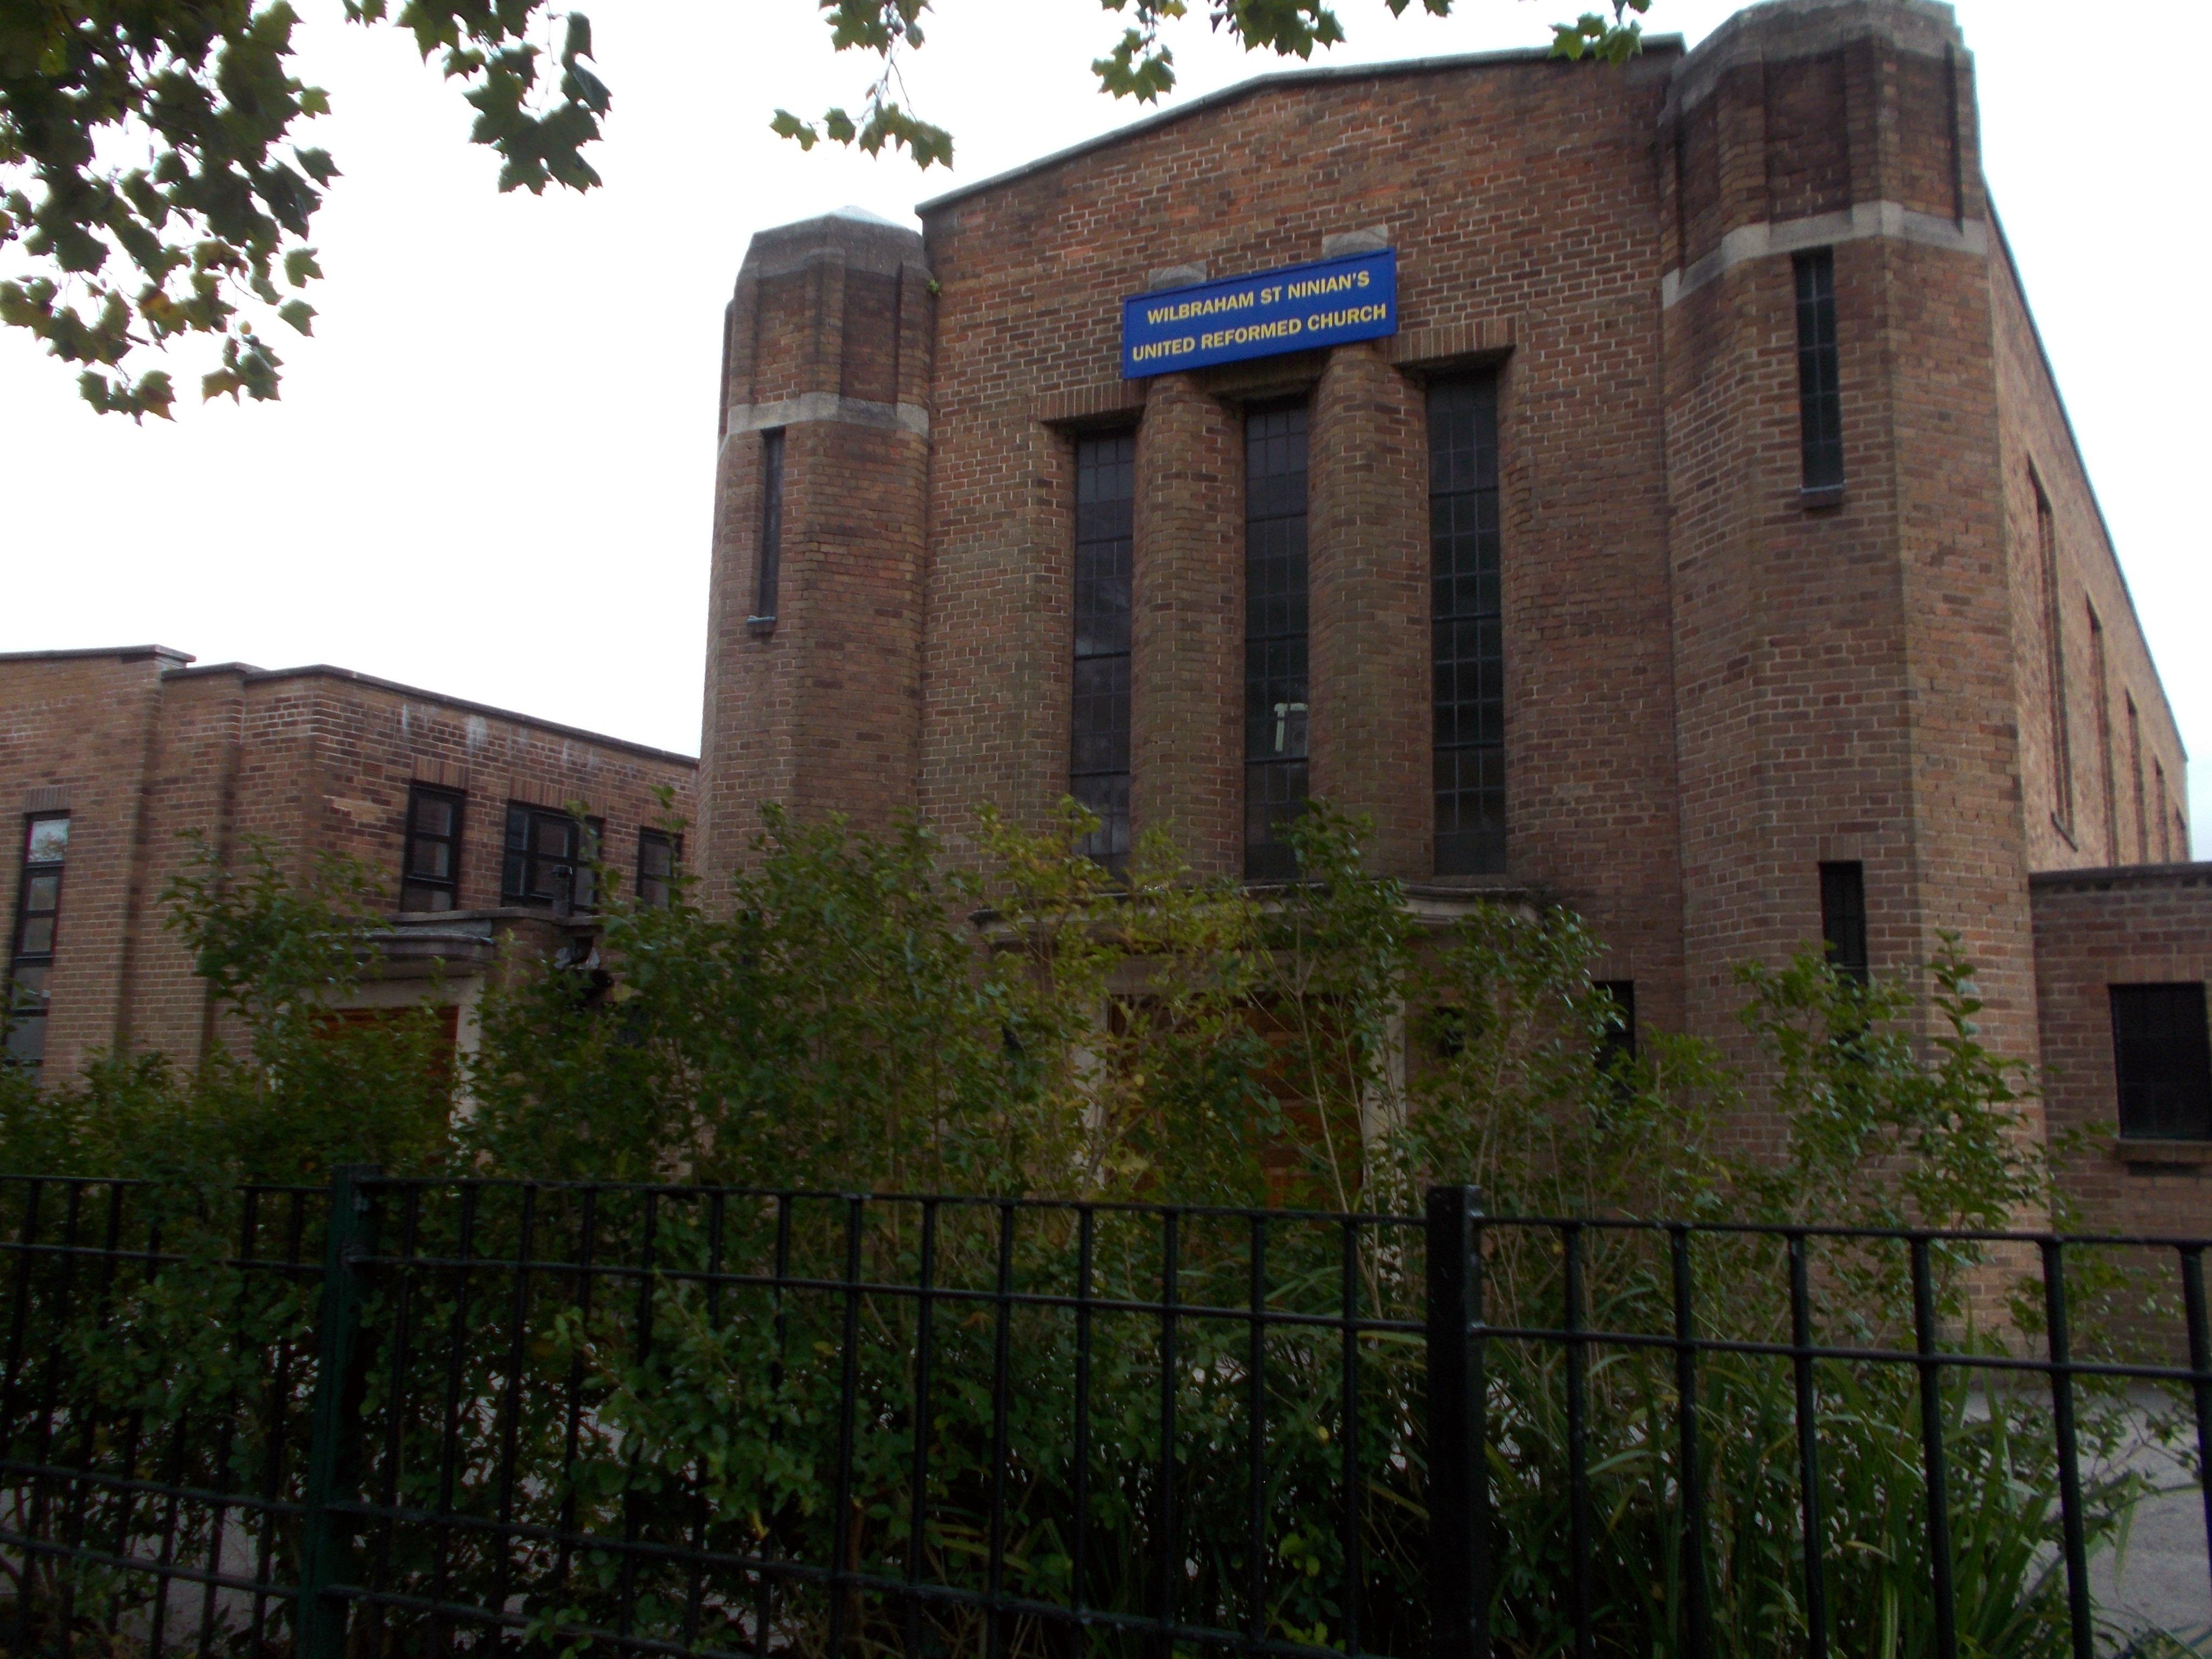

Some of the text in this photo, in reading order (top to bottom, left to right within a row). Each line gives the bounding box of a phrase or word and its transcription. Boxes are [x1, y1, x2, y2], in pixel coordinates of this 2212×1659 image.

[1147, 271, 1370, 324] WILBRAHAM ST NINIAN'S
[1132, 304, 1386, 361] UNITED REFORMED CHURCH
